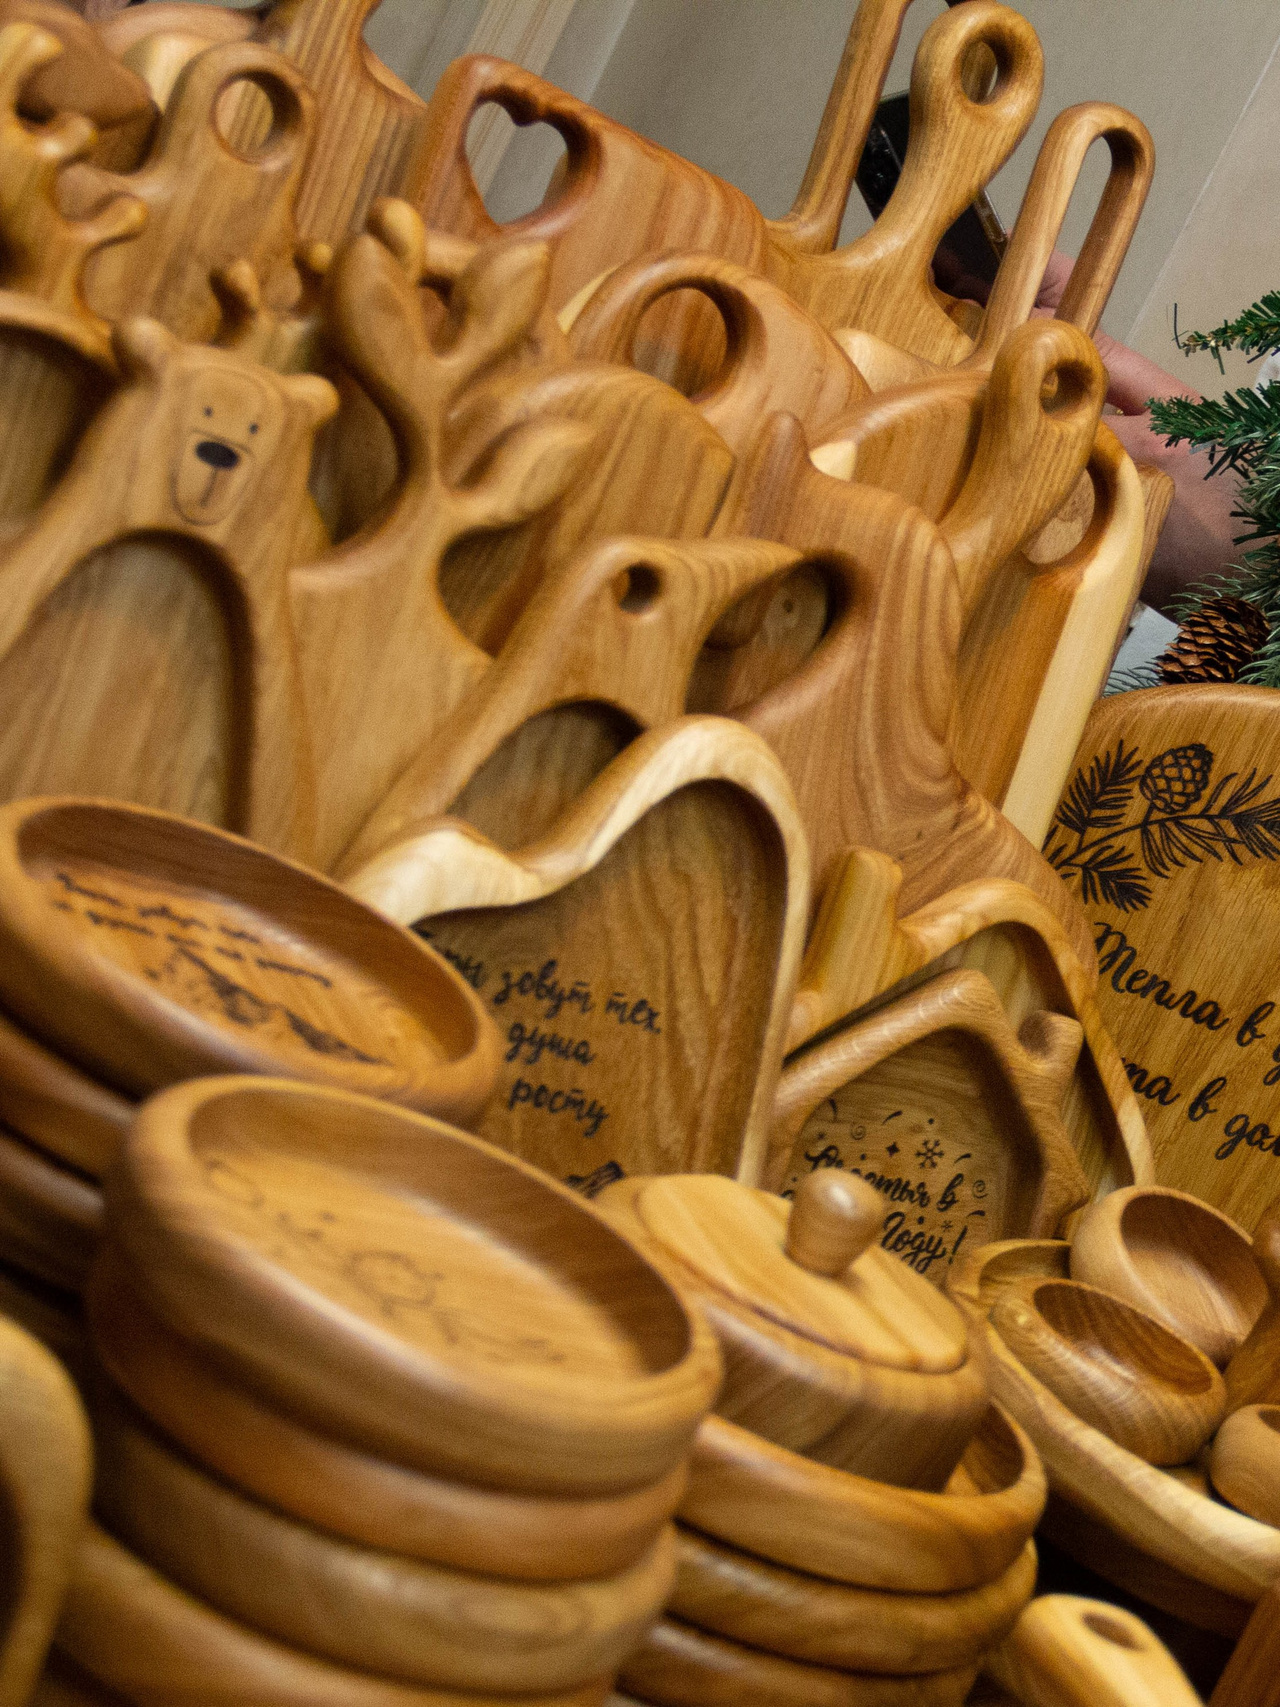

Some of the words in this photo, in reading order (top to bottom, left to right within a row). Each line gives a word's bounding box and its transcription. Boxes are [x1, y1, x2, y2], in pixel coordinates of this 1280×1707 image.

[493, 958, 596, 1020] зовут
[1093, 921, 1230, 1031] Тепла
[1236, 1000, 1276, 1048] в
[503, 1022, 595, 1067] душа
[1187, 1075, 1228, 1122] в
[935, 1172, 965, 1212] в
[880, 1210, 969, 1276] Году!
